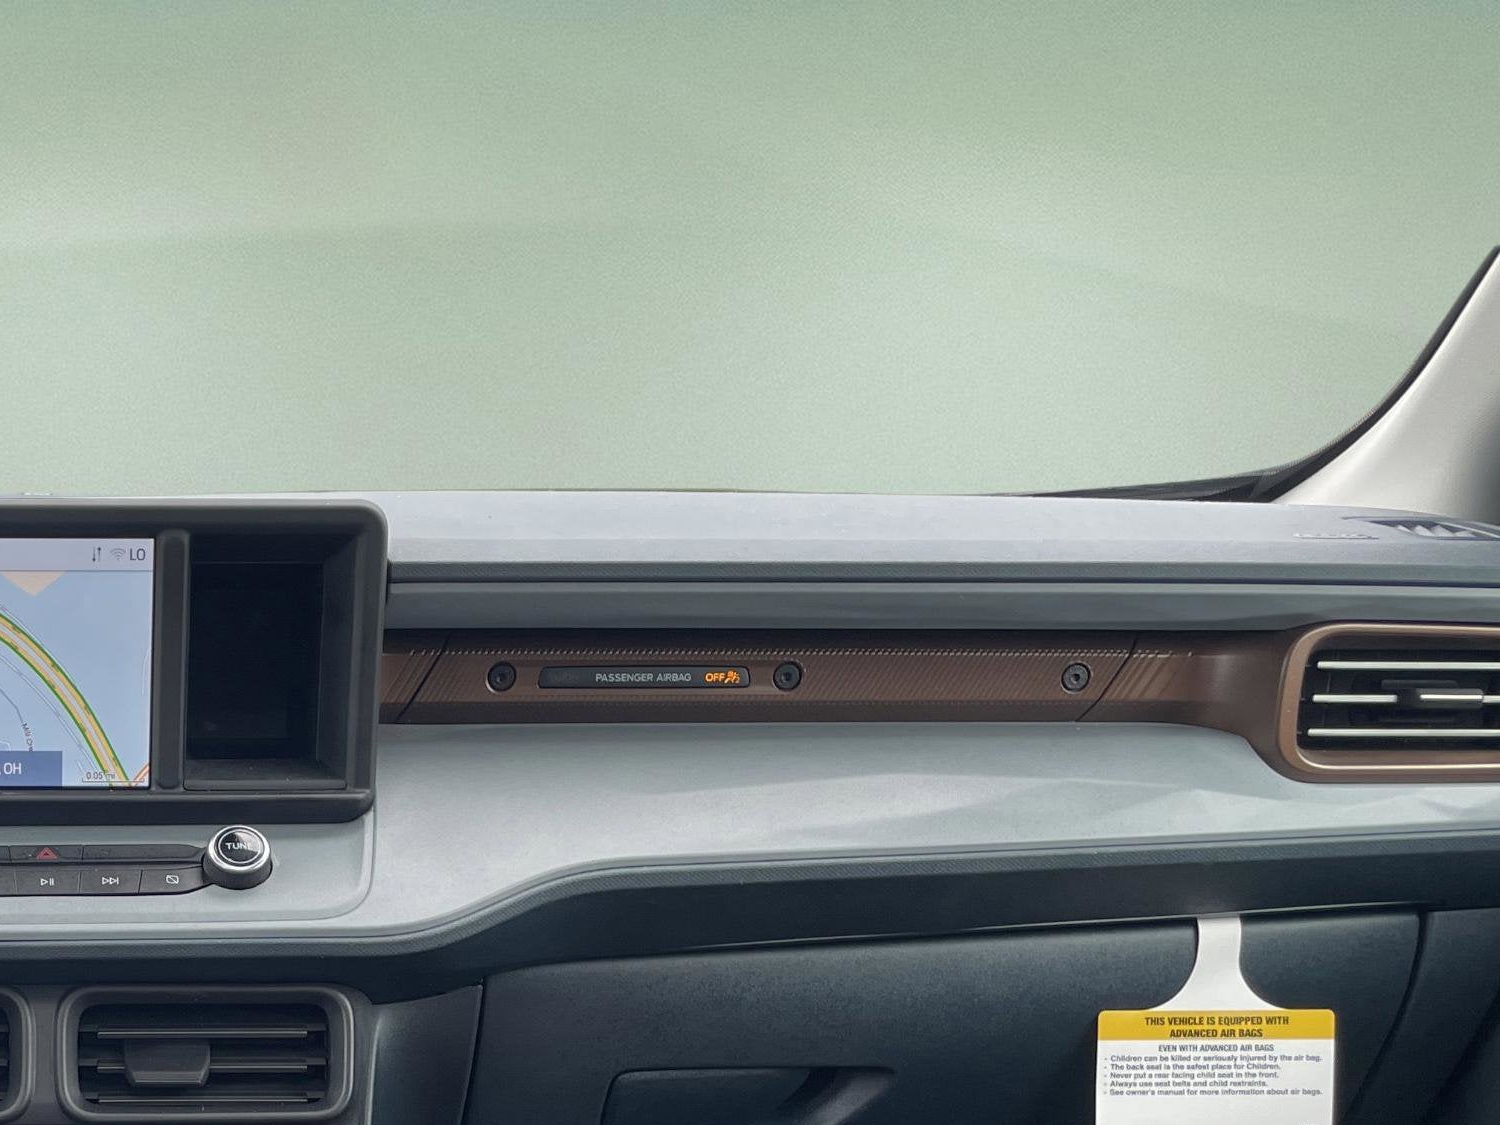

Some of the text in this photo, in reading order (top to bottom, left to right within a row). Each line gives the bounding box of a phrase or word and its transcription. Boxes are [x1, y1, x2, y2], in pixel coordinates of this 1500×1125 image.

[129, 548, 146, 561] LO
[595, 672, 725, 683] PASSENGER AIRBAG OFF
[3, 762, 22, 775] OH
[85, 771, 104, 781] 0.05
[1145, 1015, 1289, 1026] THIS VEHICLE IS EQUIPPED WITH
[1169, 1028, 1264, 1038] ADVANCED AIR BAGS
[1158, 1044, 1275, 1052] EVEN WITH ADVANCED AIR BAGS
[1203, 1055, 1238, 1063] seriously
[1240, 1055, 1266, 1063] injured
[1269, 1055, 1278, 1063] by
[1306, 1054, 1323, 1063] bag.
[1211, 1063, 1232, 1071] place
[1133, 1073, 1146, 1081] put
[1171, 1072, 1195, 1080] facing
[1110, 1081, 1137, 1089] Always
